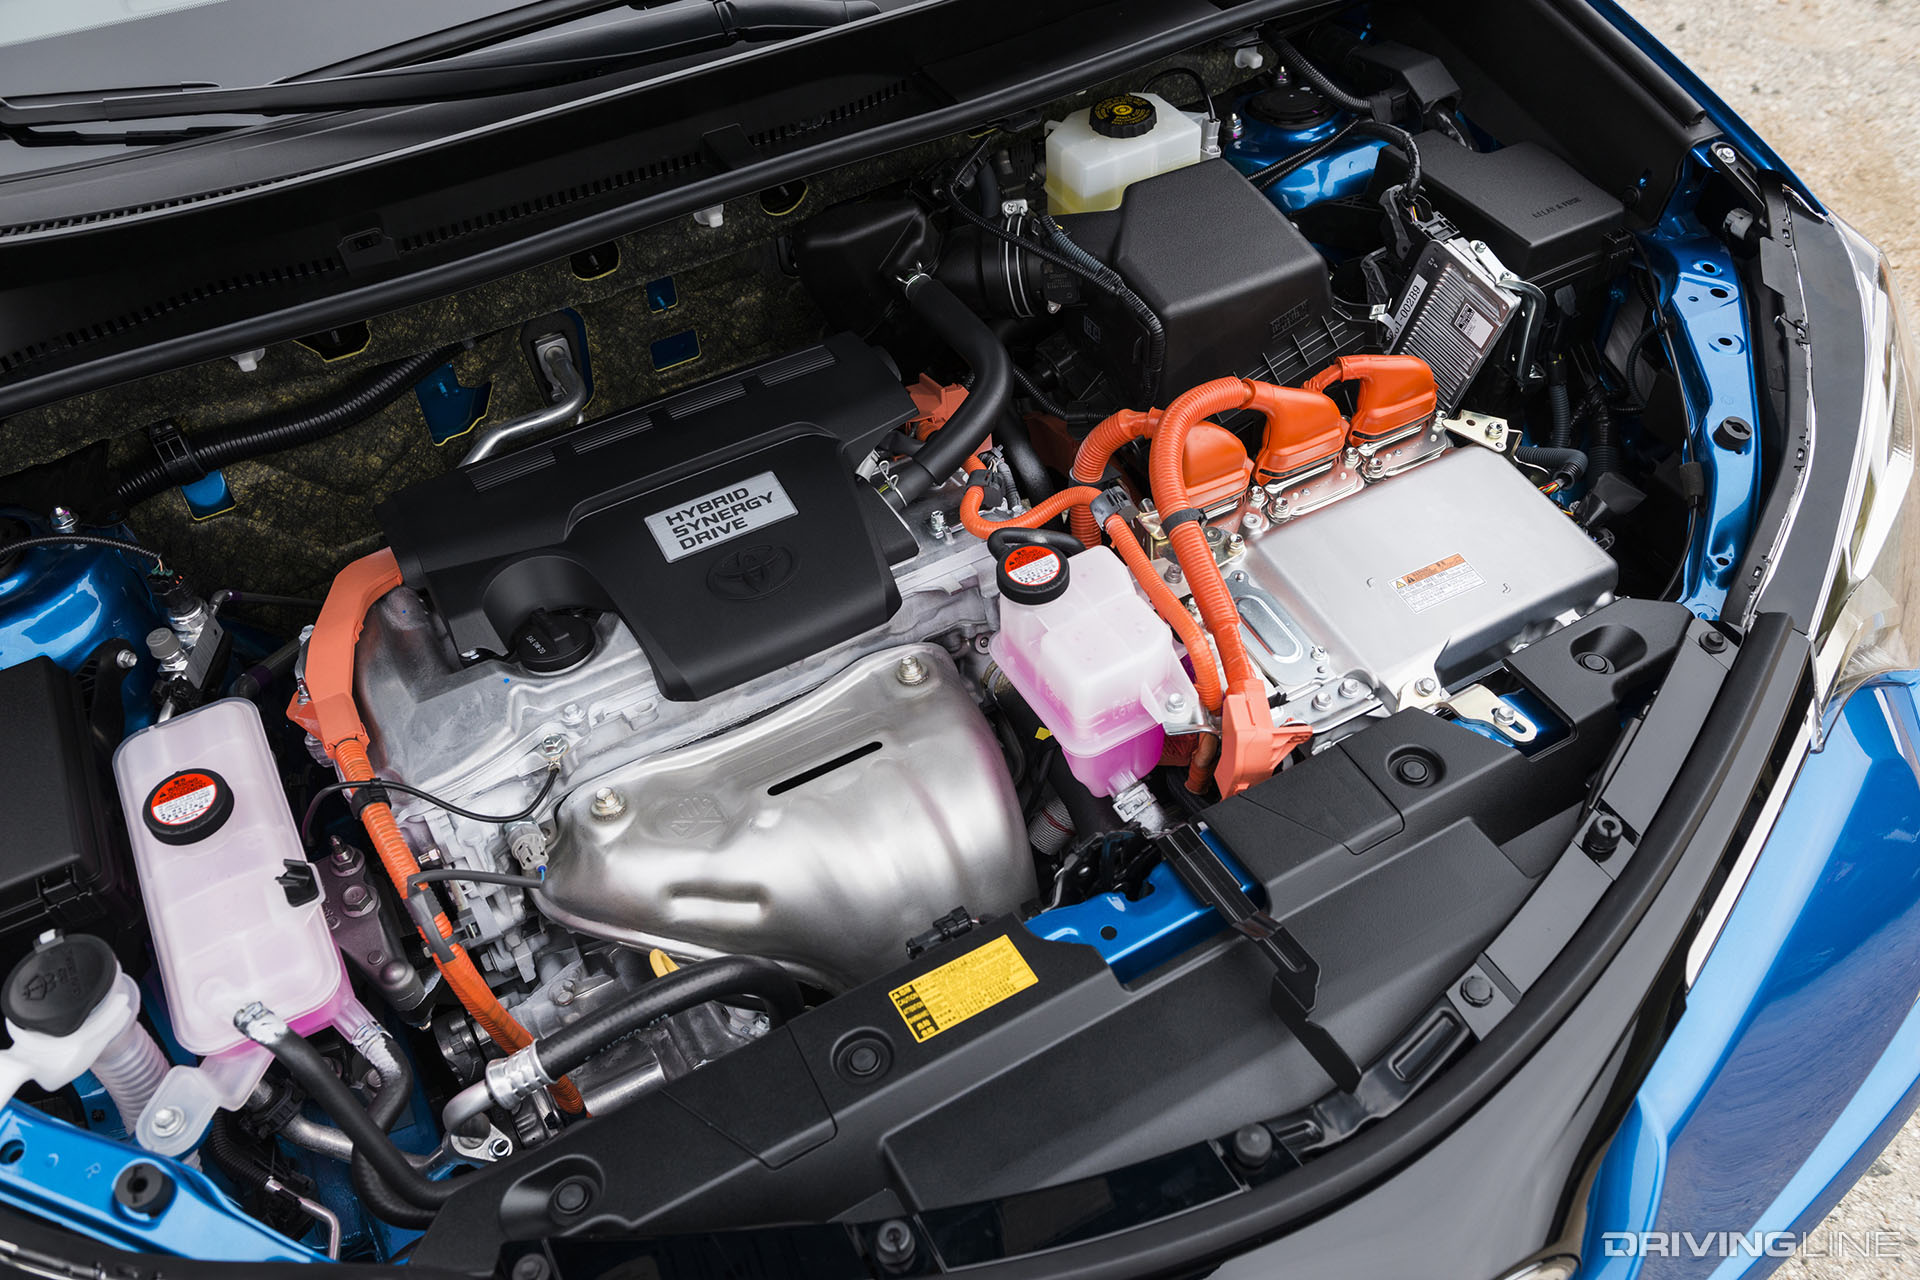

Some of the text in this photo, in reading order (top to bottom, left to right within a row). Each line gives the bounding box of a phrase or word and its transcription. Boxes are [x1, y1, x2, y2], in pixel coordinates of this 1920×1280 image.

[665, 487, 750, 526] HYBRID
[672, 491, 773, 538] SYNERGY
[678, 517, 748, 550] DRIVE
